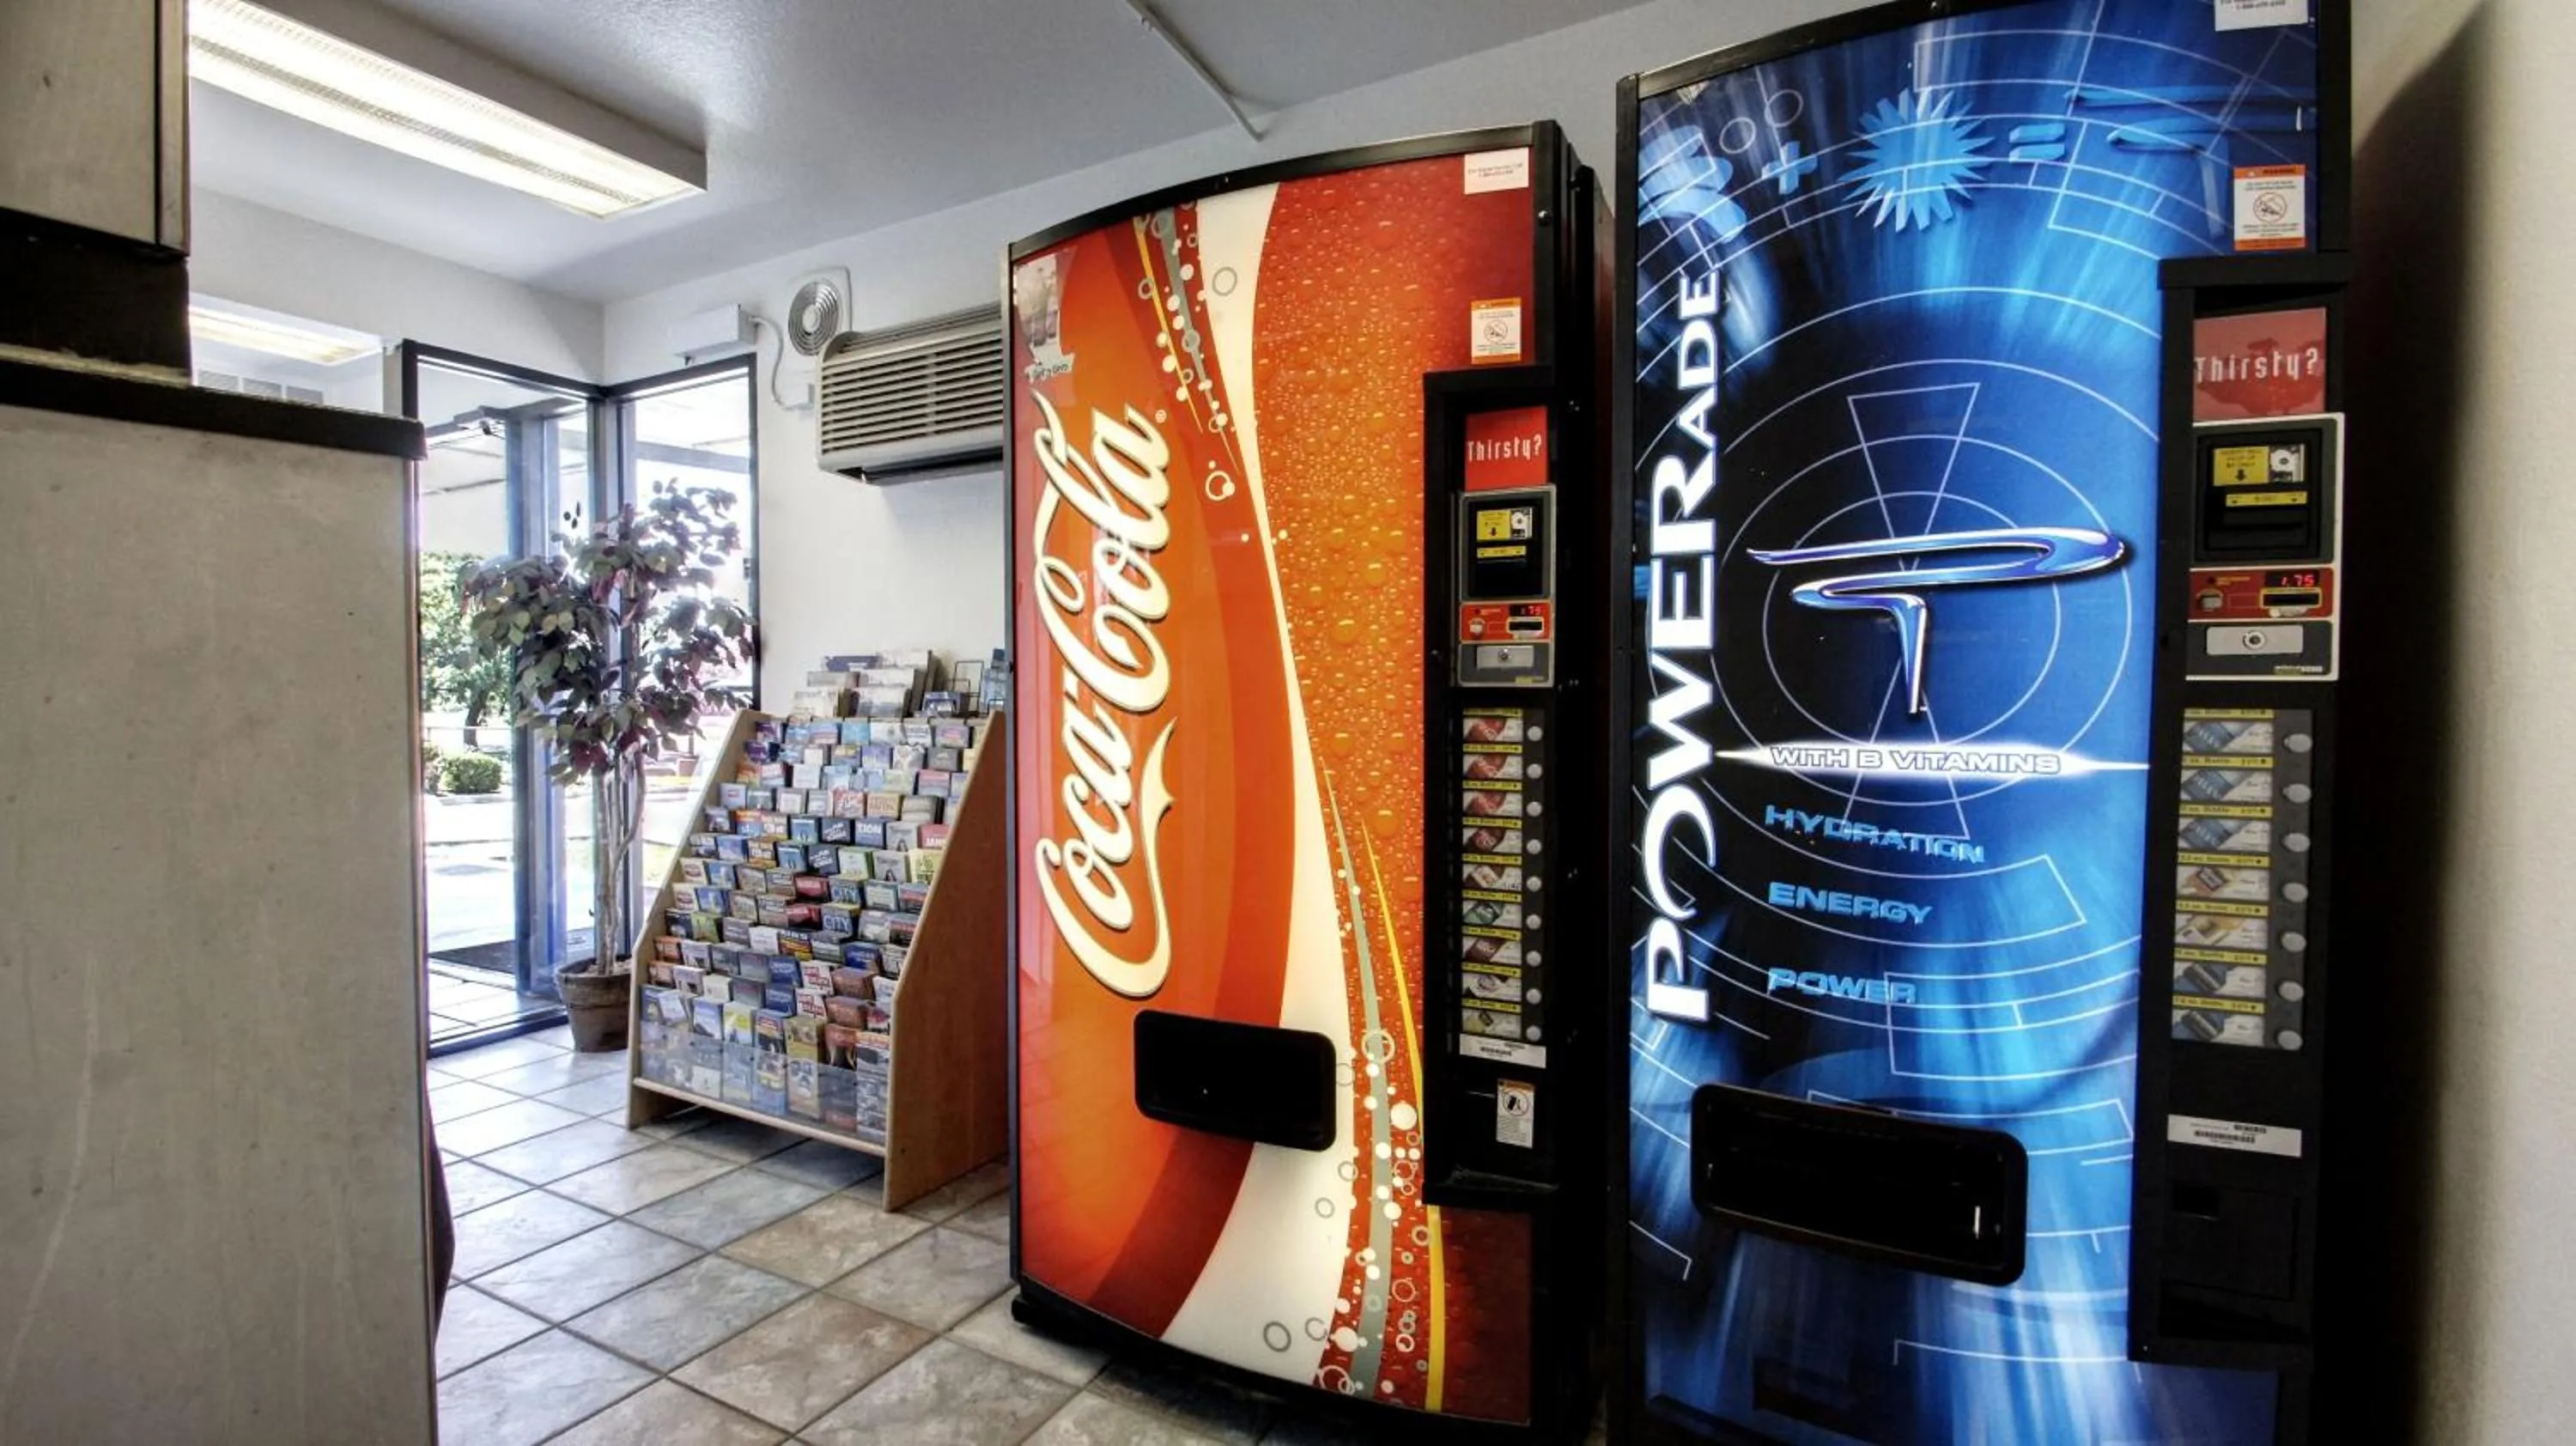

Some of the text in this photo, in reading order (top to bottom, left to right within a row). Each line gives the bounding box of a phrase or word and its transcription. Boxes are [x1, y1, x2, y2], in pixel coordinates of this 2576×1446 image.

[2194, 347, 2318, 385] Thirsty?
[1467, 432, 1543, 462] Thirsty?
[2281, 574, 2316, 586] 1.75
[1643, 268, 1719, 1022] POWERADE
[1033, 387, 1177, 998] Coca-Cola
[1771, 746, 2062, 775] WITH B VITAMINS
[1765, 804, 1985, 864] HYDRATION
[1767, 881, 1934, 926] ENERGY
[1767, 966, 1917, 1005] POWER
